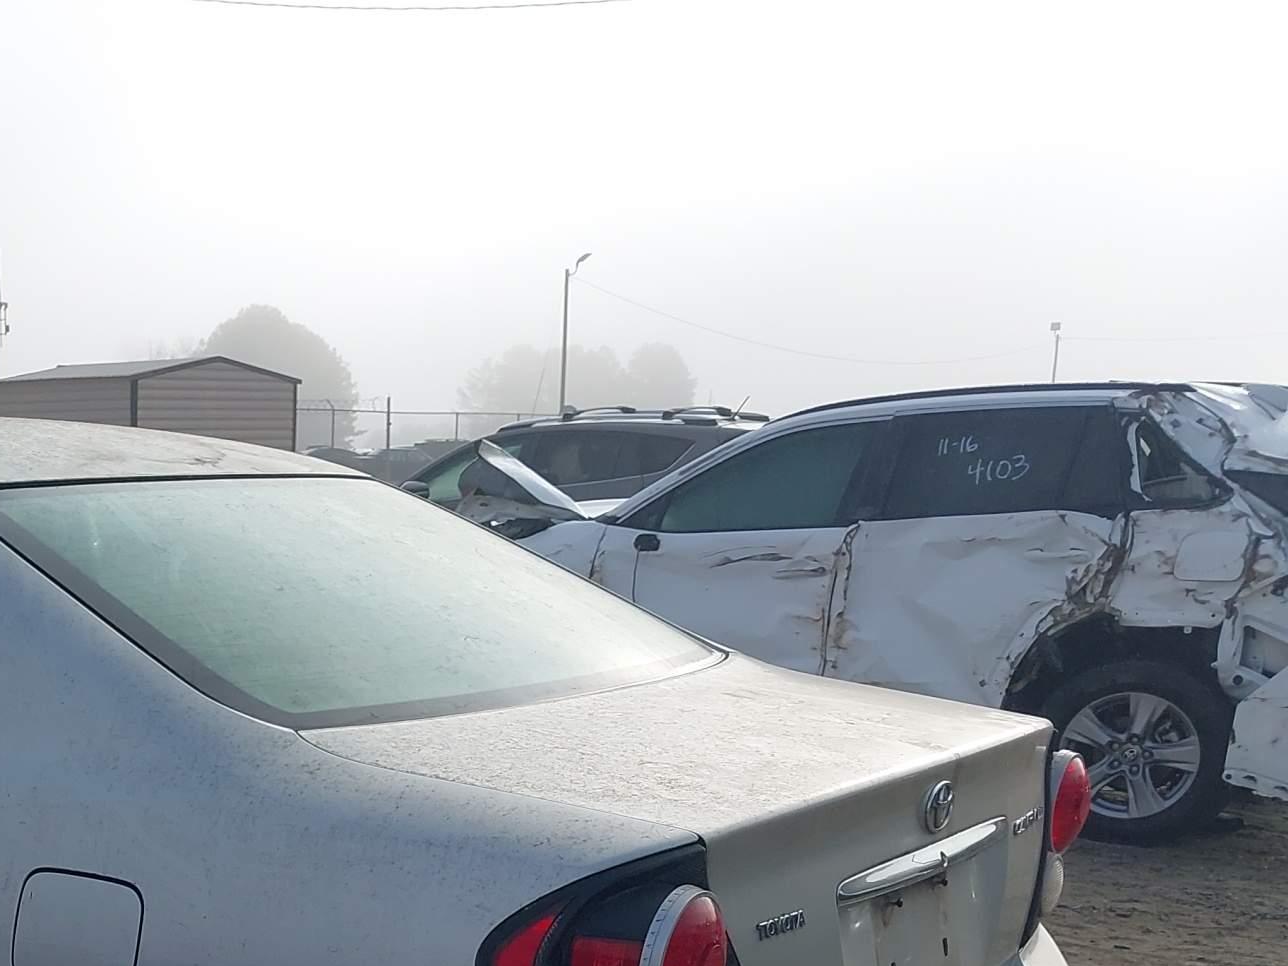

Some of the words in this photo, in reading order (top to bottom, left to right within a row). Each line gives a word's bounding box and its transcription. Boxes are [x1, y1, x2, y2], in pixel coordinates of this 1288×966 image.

[938, 435, 979, 456] 11-16
[967, 454, 1030, 485] 4103
[756, 909, 807, 941] TOYOTA
